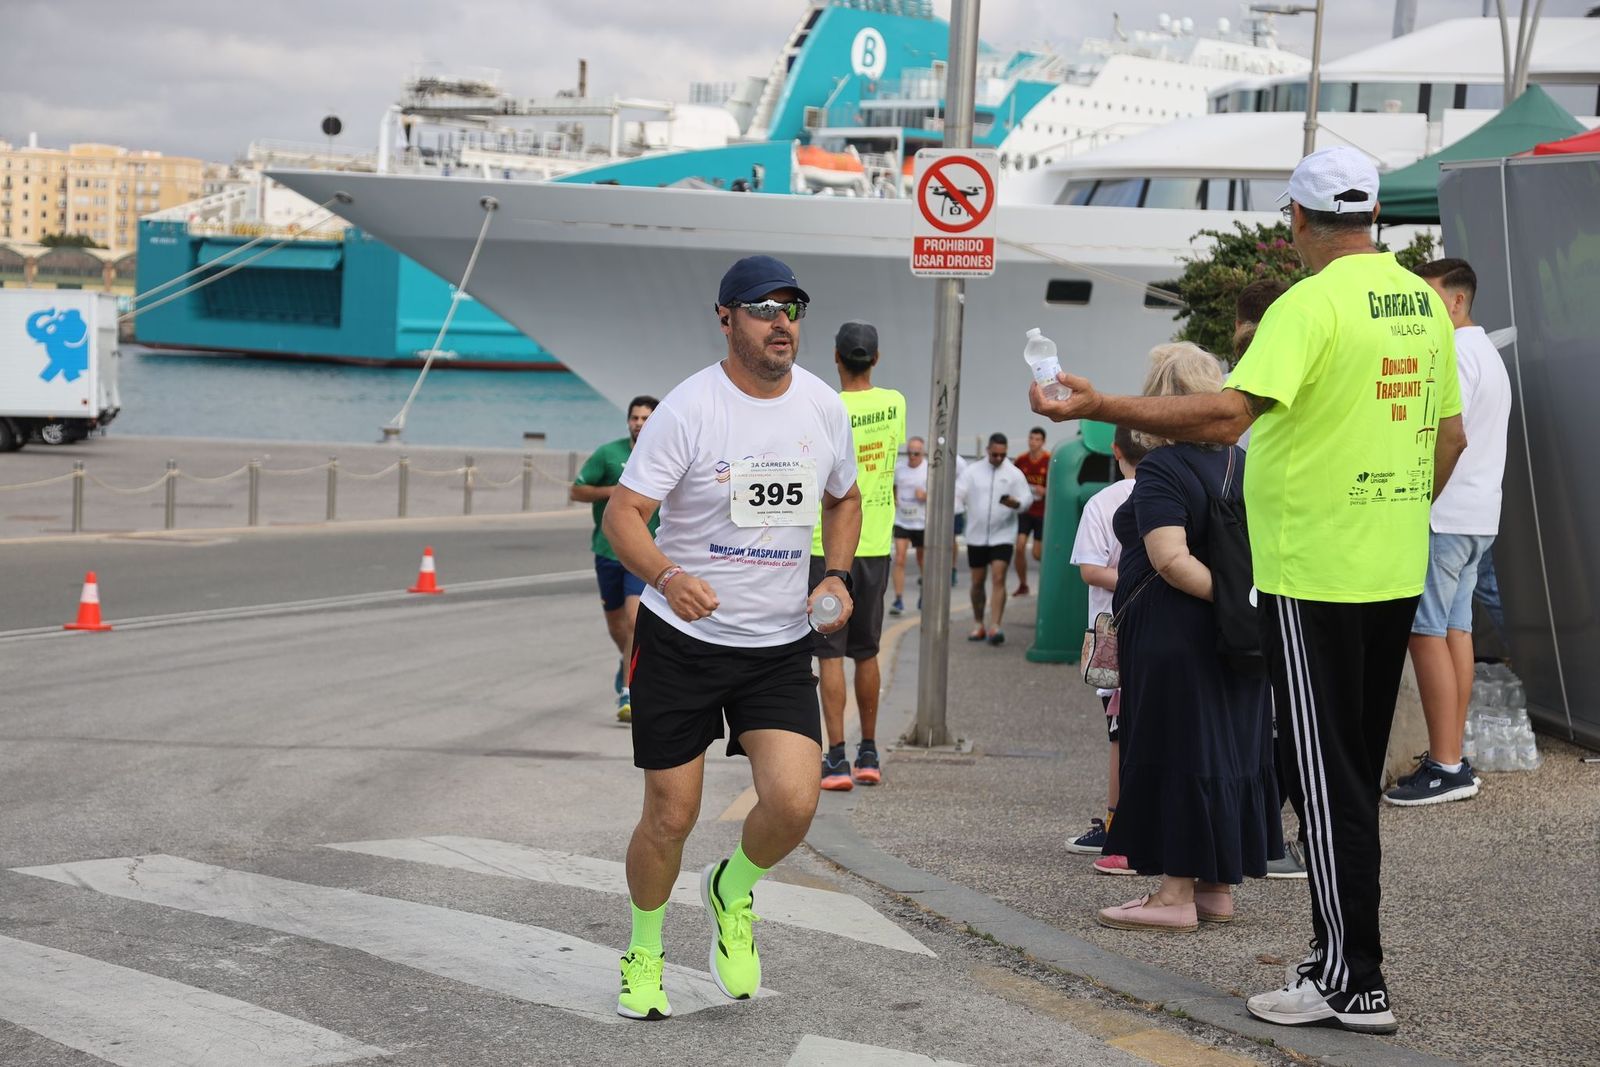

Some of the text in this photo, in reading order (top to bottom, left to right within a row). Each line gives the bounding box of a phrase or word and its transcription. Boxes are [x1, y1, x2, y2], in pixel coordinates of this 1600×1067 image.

[862, 36, 876, 67] B
[923, 238, 984, 252] PROHIBIDO
[914, 254, 992, 268] USAR DRONES
[1415, 291, 1433, 318] 5K
[1391, 322, 1428, 336] MÁLAGA
[749, 482, 803, 507] 395
[747, 548, 790, 560] TRASPLANTE
[736, 556, 756, 565] Vicente
[756, 559, 781, 567] Granados
[1345, 990, 1387, 1012] AIR
